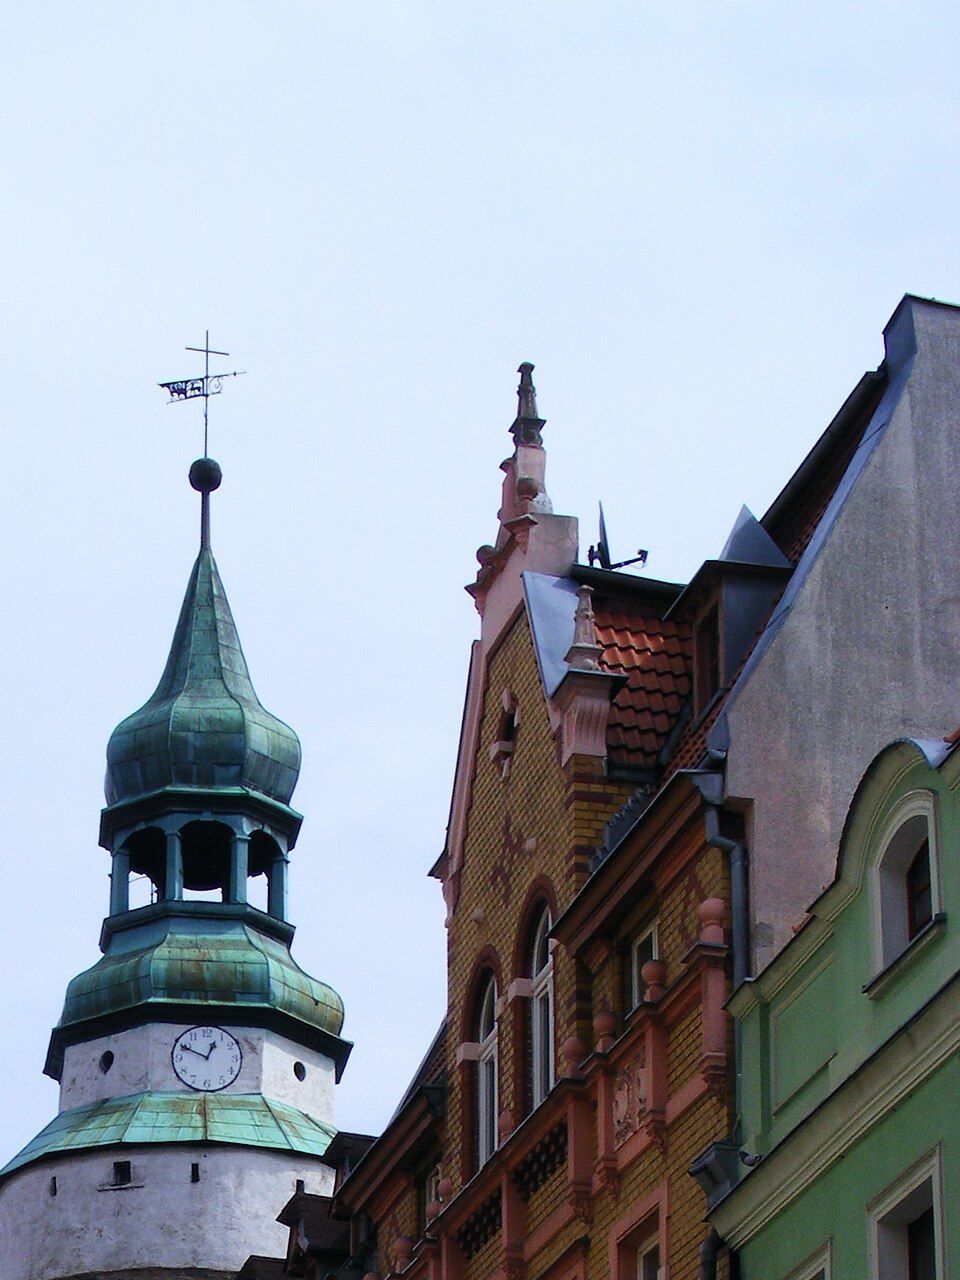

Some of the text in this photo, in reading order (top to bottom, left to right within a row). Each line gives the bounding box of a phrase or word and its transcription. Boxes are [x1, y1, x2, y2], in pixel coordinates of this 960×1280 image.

[190, 1032, 197, 1041] 11
[202, 1029, 212, 1038] 12
[227, 1041, 234, 1050] 2
[175, 1054, 182, 1062] 9
[231, 1054, 238, 1062] 3
[180, 1066, 187, 1074] 8
[227, 1066, 235, 1075] 4
[190, 1074, 196, 1084] 7
[203, 1079, 211, 1088] 6
[219, 1075, 225, 1084] 5
